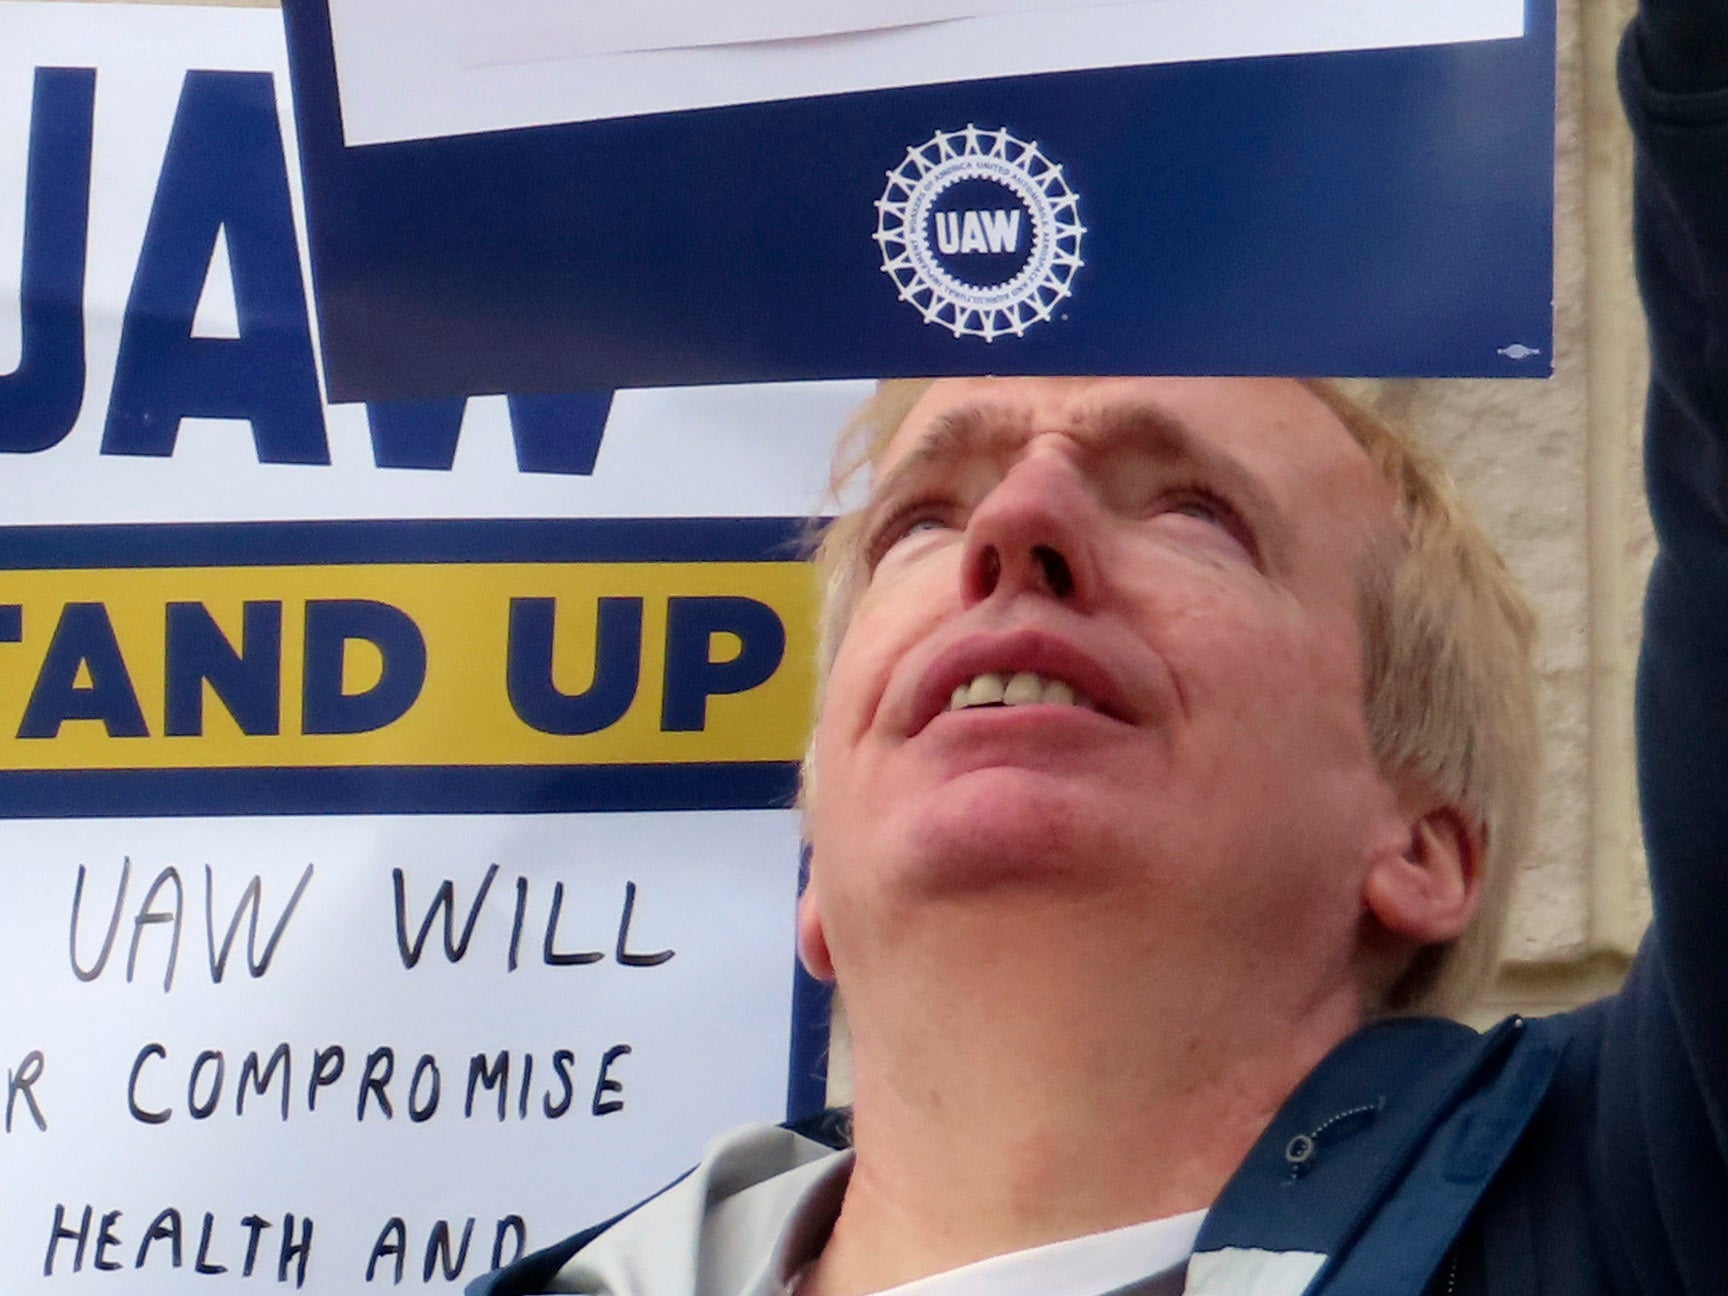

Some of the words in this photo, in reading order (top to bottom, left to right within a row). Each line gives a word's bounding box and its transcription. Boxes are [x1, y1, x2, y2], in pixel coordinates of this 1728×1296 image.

[934, 209, 1021, 255] UAW
[505, 594, 787, 736] UP
[69, 855, 314, 994] UAW
[391, 863, 675, 972] WILL
[127, 1041, 632, 1125] COMPROMISE
[43, 1203, 314, 1290] HEALTH
[365, 1213, 527, 1286] AND
